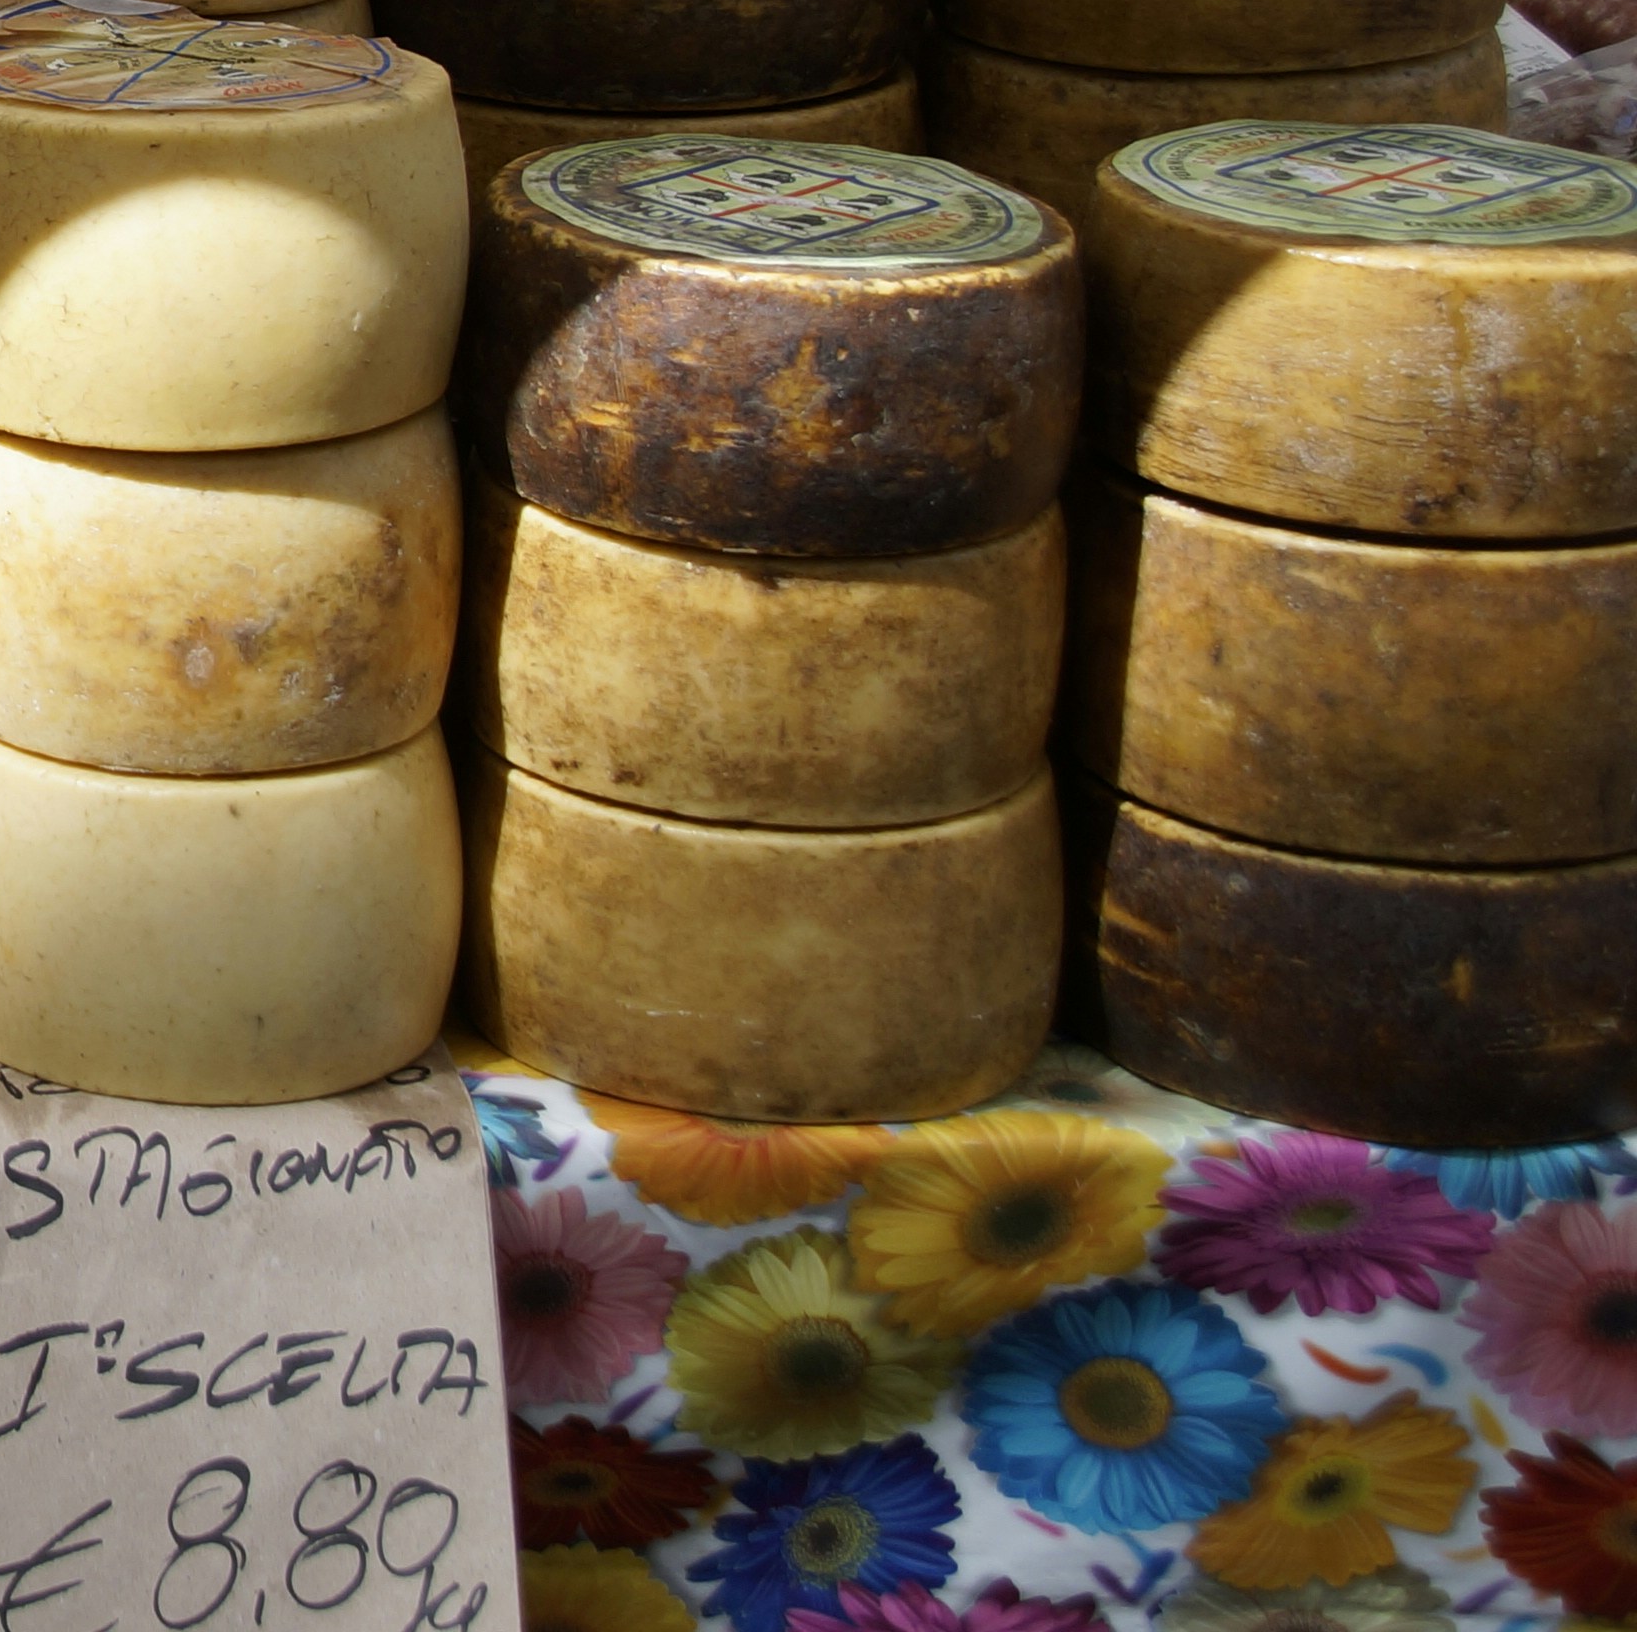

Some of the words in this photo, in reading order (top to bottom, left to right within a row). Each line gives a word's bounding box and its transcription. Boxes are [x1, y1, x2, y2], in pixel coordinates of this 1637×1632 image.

[1378, 134, 1426, 147] LE
[1427, 141, 1451, 150] 4
[1455, 146, 1567, 172] MORE
[600, 200, 701, 226] MORE
[115, 1328, 489, 1421] SCELTA
